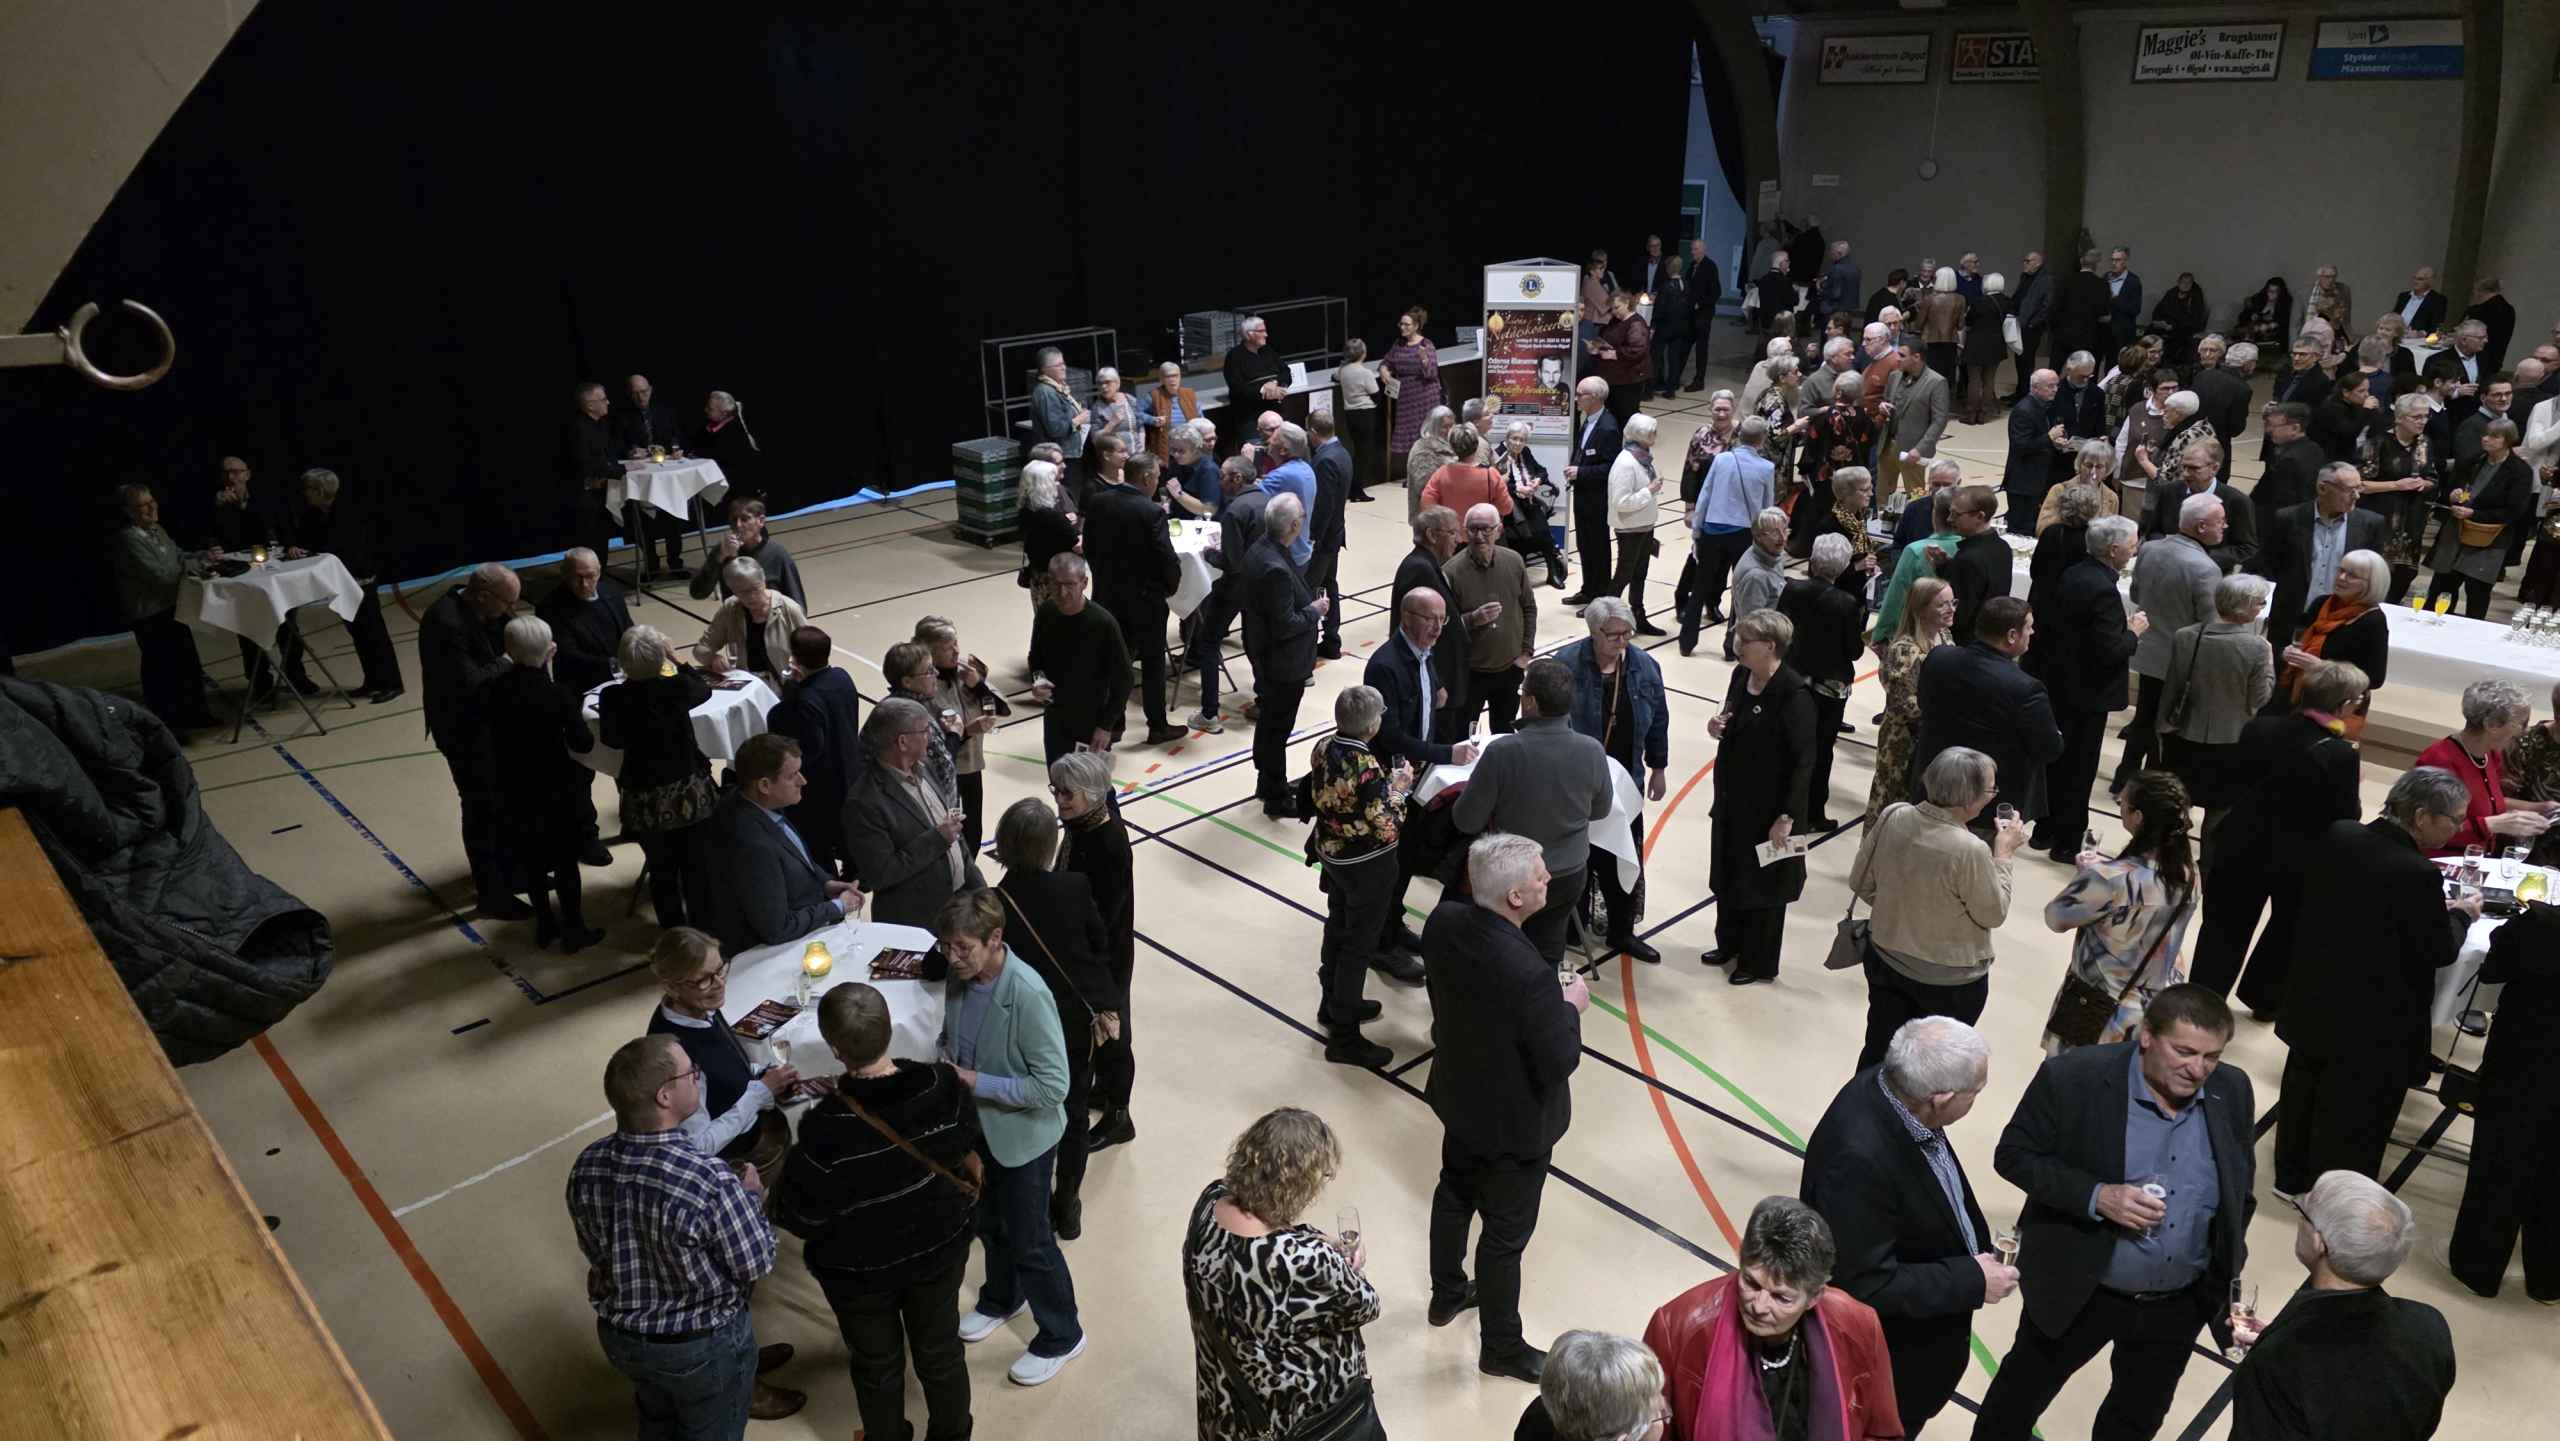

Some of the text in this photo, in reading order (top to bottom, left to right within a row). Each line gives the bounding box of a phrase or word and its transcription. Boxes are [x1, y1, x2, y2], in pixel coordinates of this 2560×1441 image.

[1990, 39, 2039, 65] STA
[2143, 29, 2277, 57] Maggie's Brugskunst
[2190, 48, 2274, 60] Øl-Vin-Kaffe-The
[2213, 63, 2271, 75] www.maggies.dk
